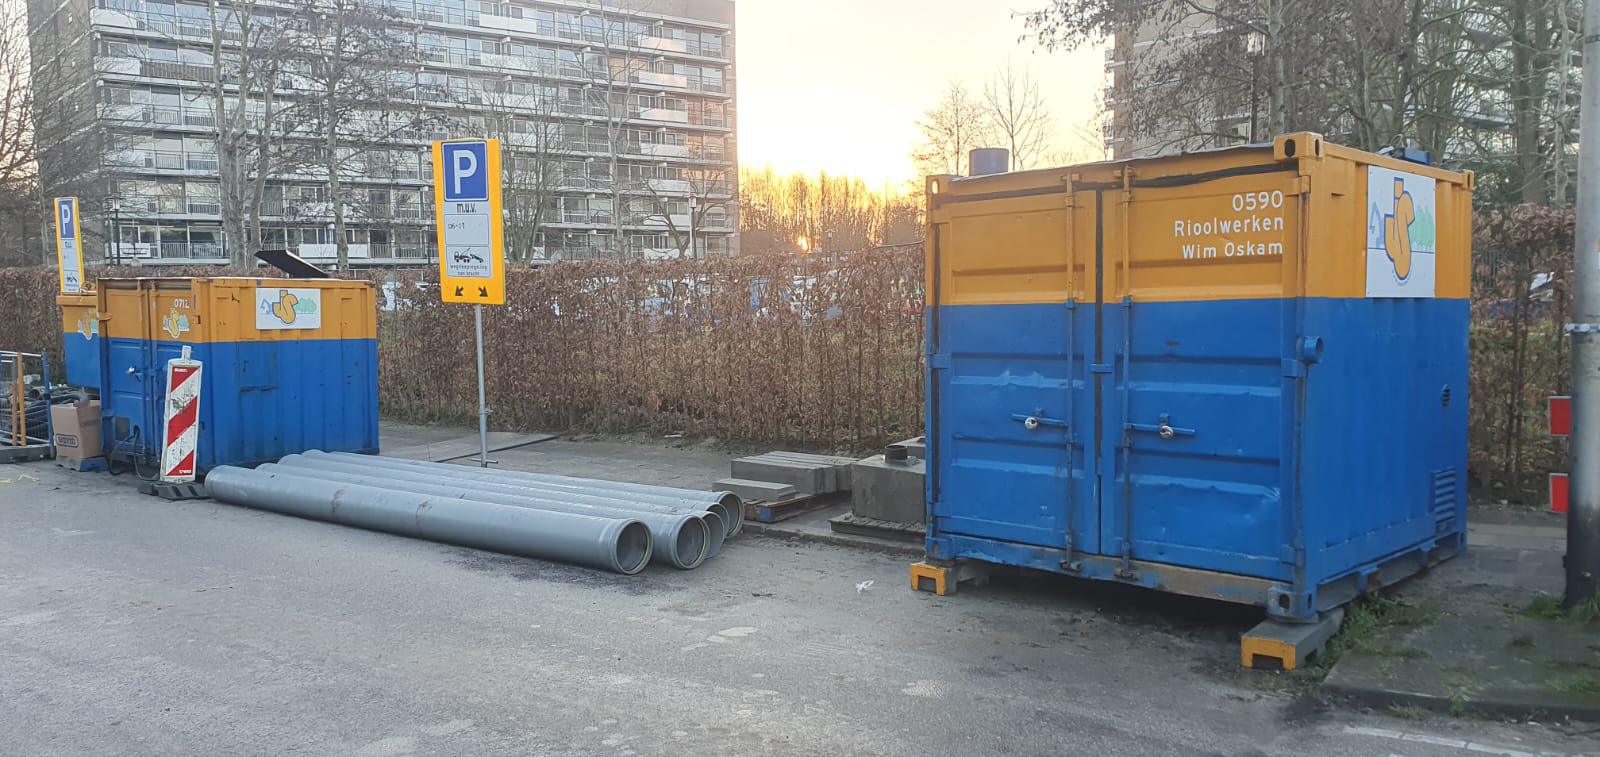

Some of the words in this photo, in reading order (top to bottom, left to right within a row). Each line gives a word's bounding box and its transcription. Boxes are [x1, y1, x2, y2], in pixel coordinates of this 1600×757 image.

[453, 150, 478, 194] P
[1232, 190, 1283, 212] 0590
[61, 204, 71, 235] P
[1174, 214, 1284, 237] Rioolwerken
[1182, 244, 1217, 259] Wim
[1224, 241, 1283, 257] Oskam
[174, 298, 190, 309] 0712
